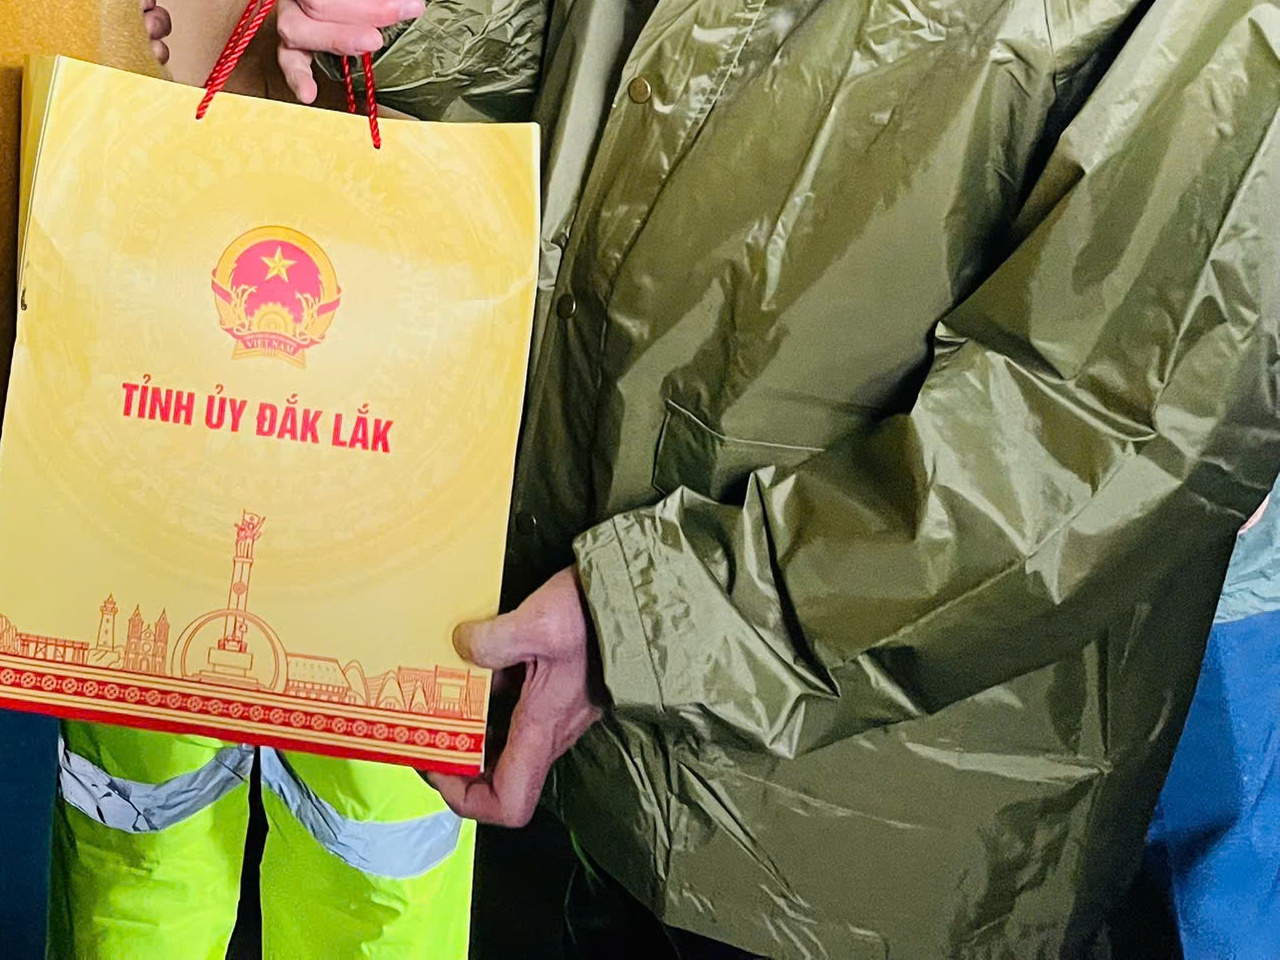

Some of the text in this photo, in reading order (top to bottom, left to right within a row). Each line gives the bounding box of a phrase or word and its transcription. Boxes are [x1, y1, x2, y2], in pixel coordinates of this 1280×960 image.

[122, 373, 395, 454] TỈNH ỦY ĐẮK LẮK
